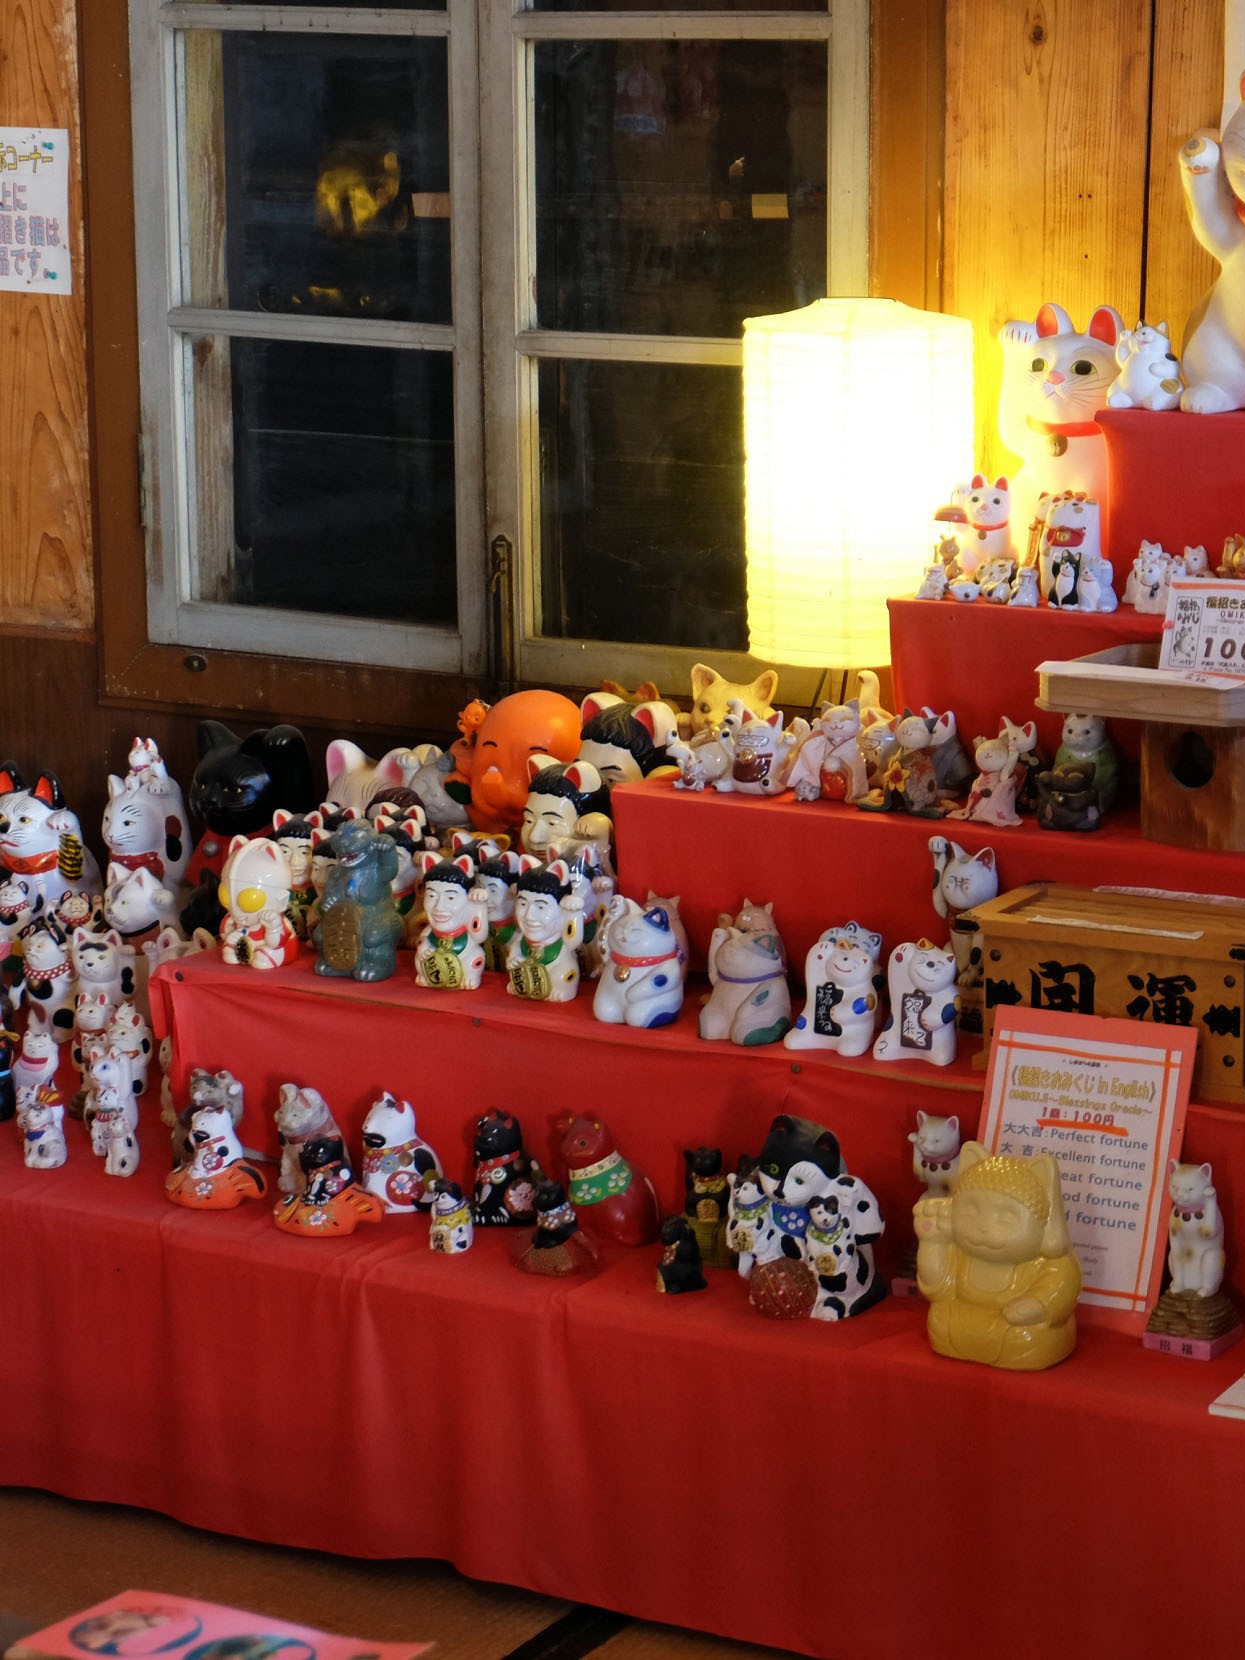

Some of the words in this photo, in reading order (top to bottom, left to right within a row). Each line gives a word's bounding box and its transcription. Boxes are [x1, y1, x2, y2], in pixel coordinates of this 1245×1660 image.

[1100, 1134, 1149, 1152] fortune
[1100, 1151, 1146, 1171] fortune
[1061, 1171, 1083, 1184] eat
[1088, 1172, 1143, 1191] fortune
[1086, 1192, 1140, 1211] fortune
[1076, 1211, 1137, 1231] fortune
